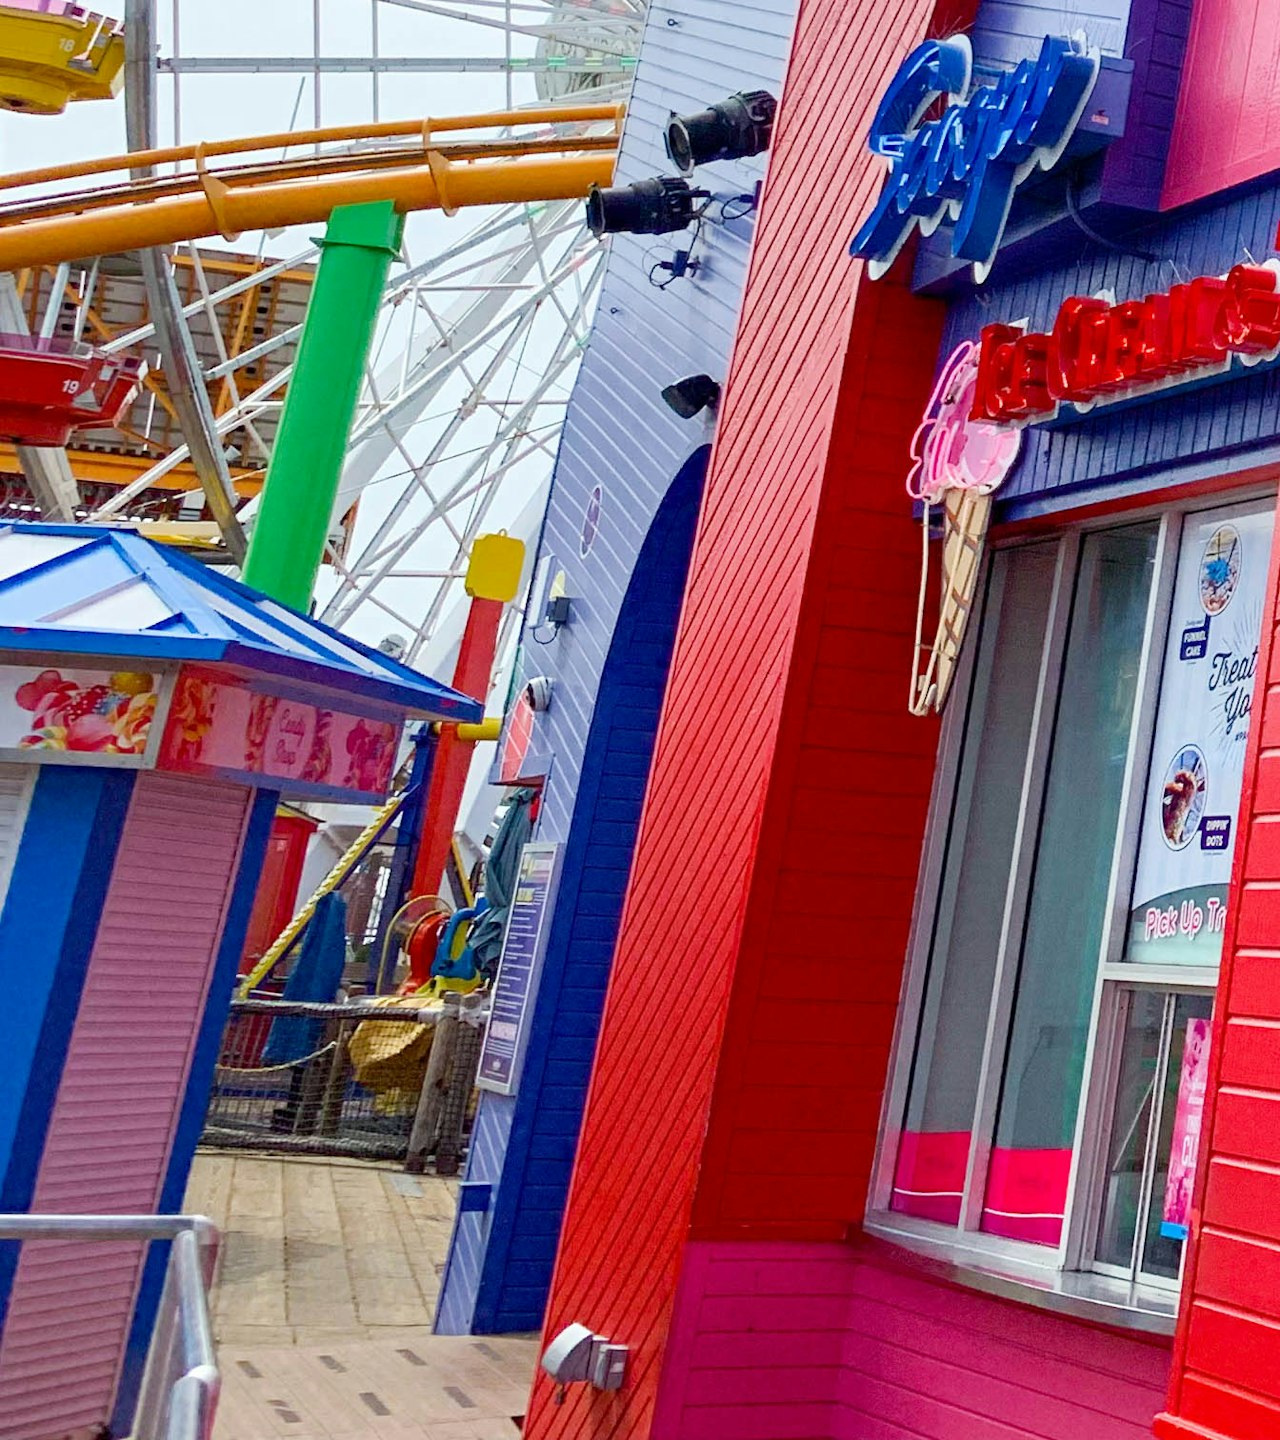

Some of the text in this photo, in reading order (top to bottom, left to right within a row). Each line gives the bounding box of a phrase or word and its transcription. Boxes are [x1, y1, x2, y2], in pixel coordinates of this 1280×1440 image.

[58, 37, 76, 53] 18
[62, 378, 80, 394] 19
[1209, 645, 1258, 691] Treat
[1145, 899, 1203, 942] Pick Up
